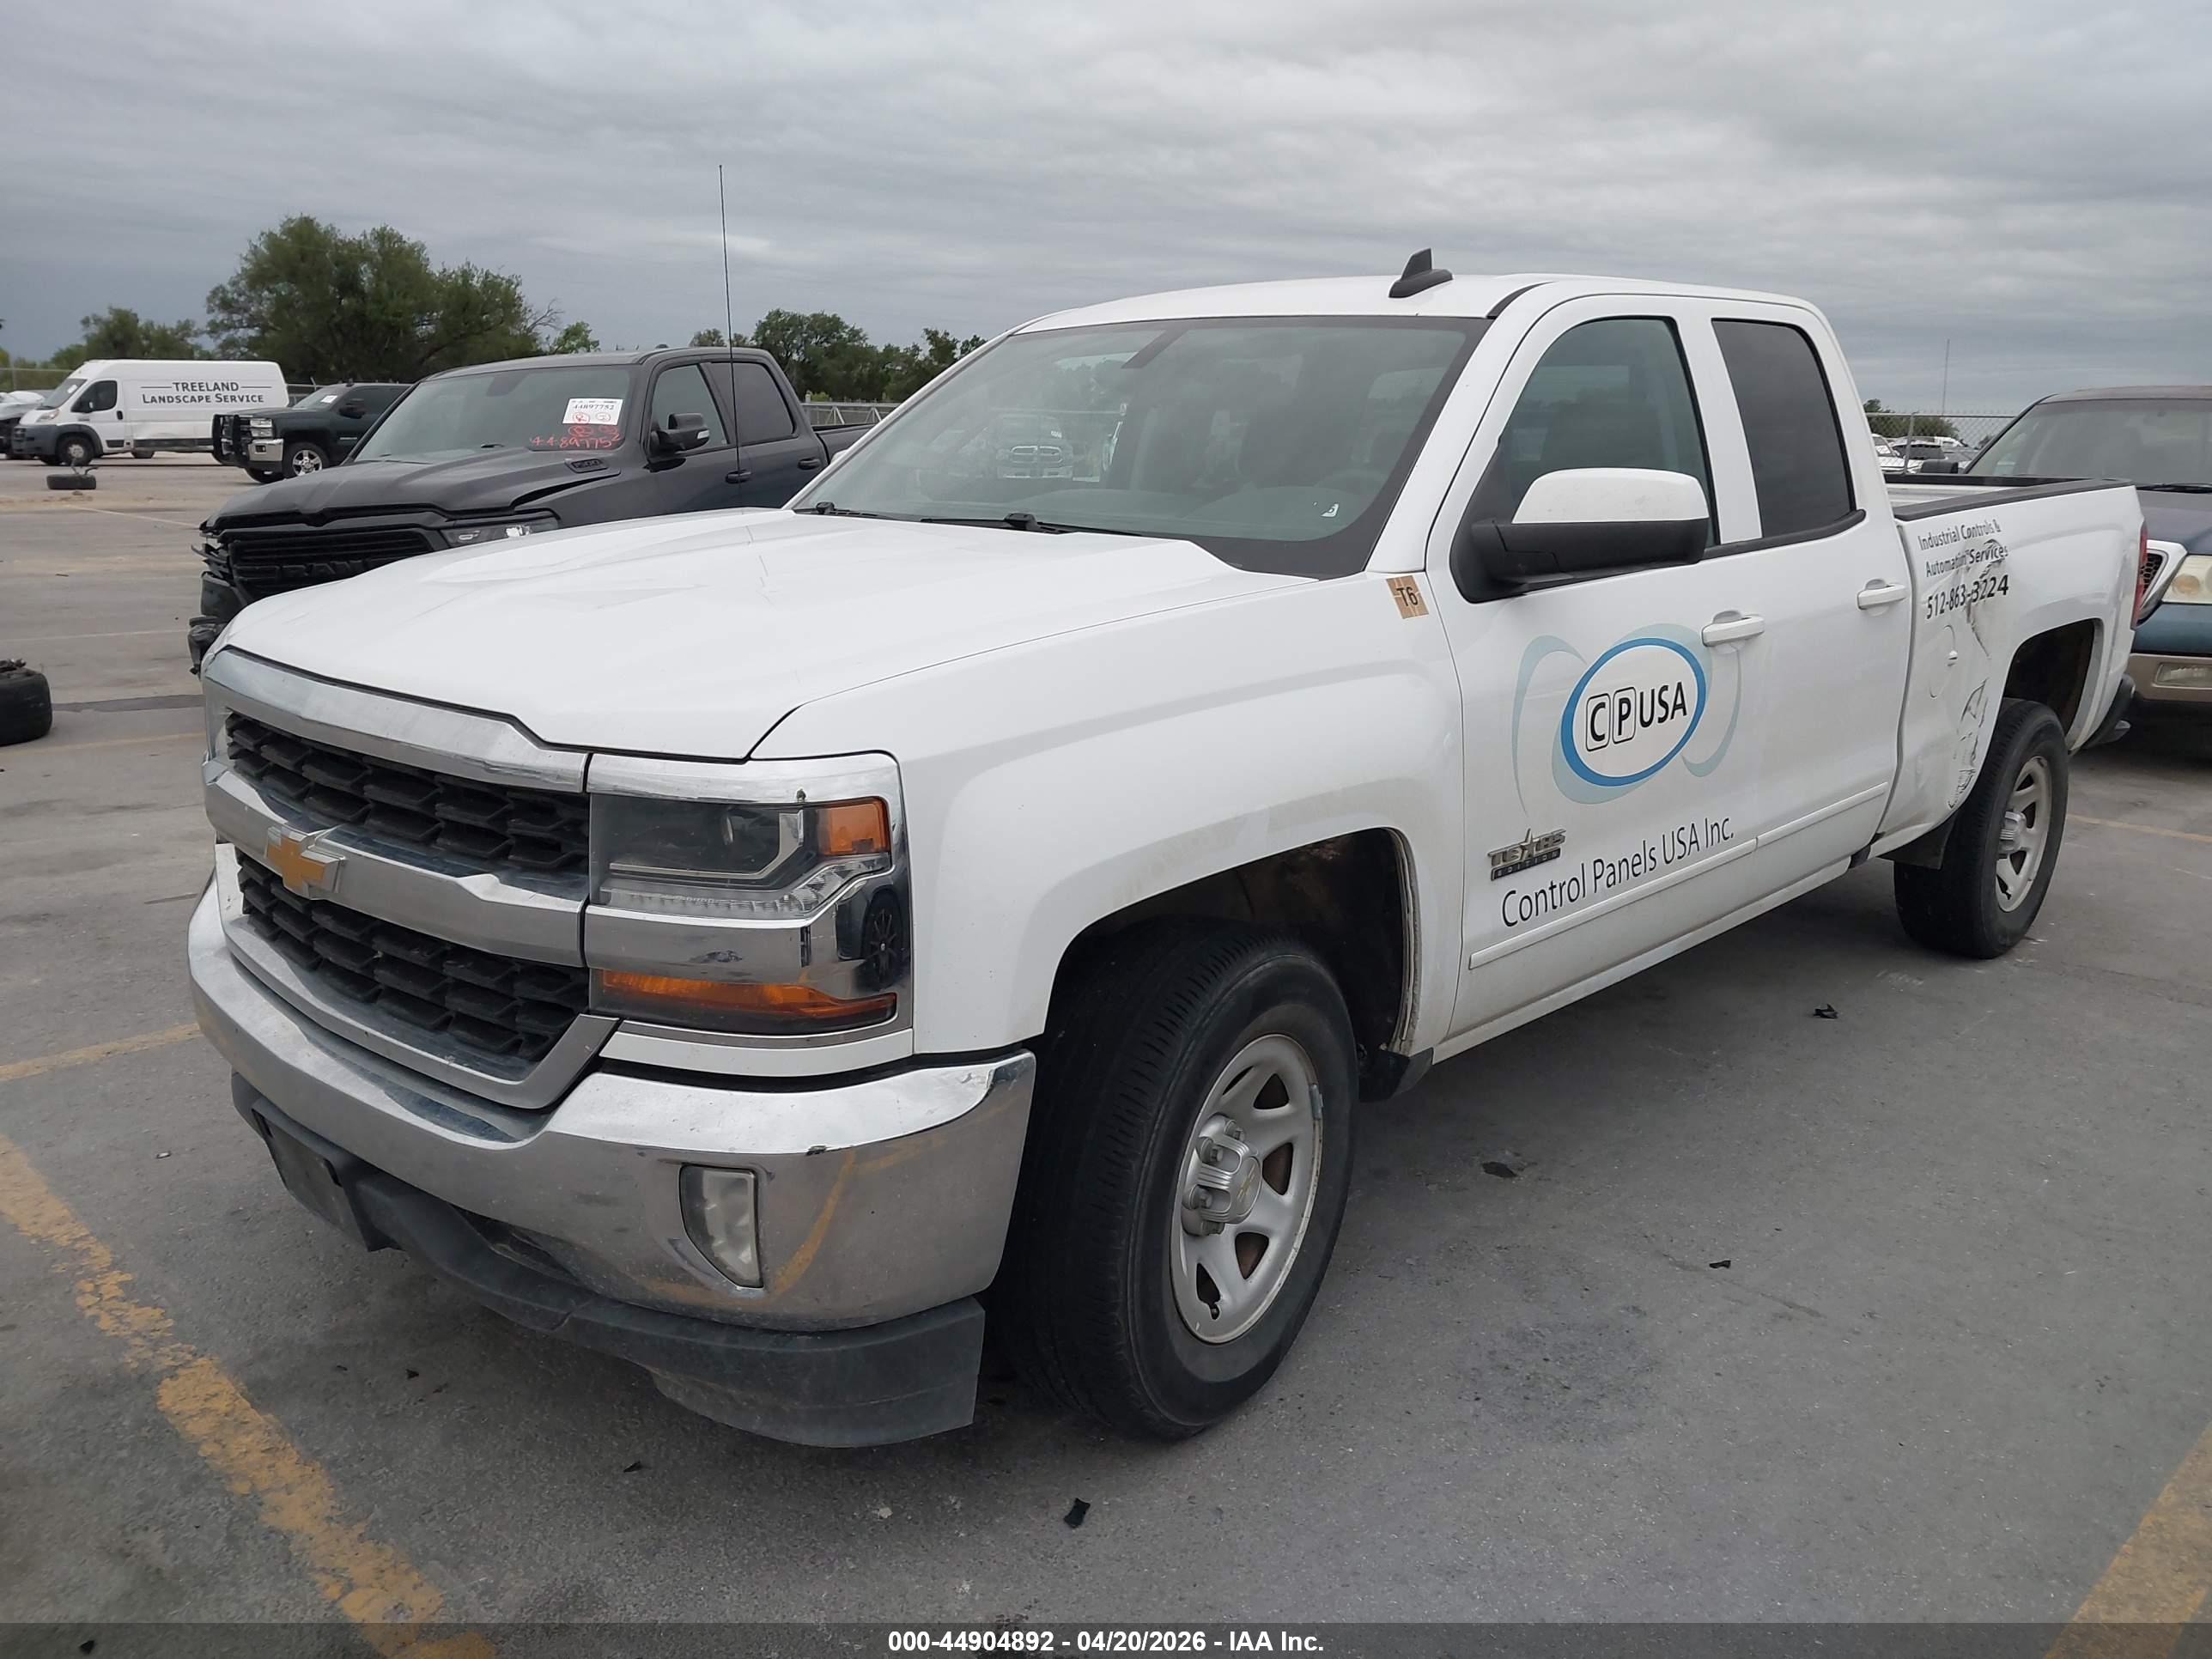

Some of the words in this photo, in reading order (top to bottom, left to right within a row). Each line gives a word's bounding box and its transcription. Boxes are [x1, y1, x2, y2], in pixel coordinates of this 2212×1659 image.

[142, 393, 212, 404] LANDSCAPE
[215, 392, 264, 404] SERVICE
[172, 381, 240, 392] TREELAND
[1917, 525, 1960, 550] Industrial
[1960, 521, 1994, 540] Controls
[1969, 544, 2008, 564] Services
[1396, 586, 1419, 607] T6
[1926, 574, 2009, 620] 512-863-3224
[1487, 828, 1567, 867] TEXAS
[1501, 862, 1586, 927] Control
[1593, 840, 1657, 891] Panels
[1662, 823, 1699, 863] USA
[1704, 816, 1735, 849] Inc.
